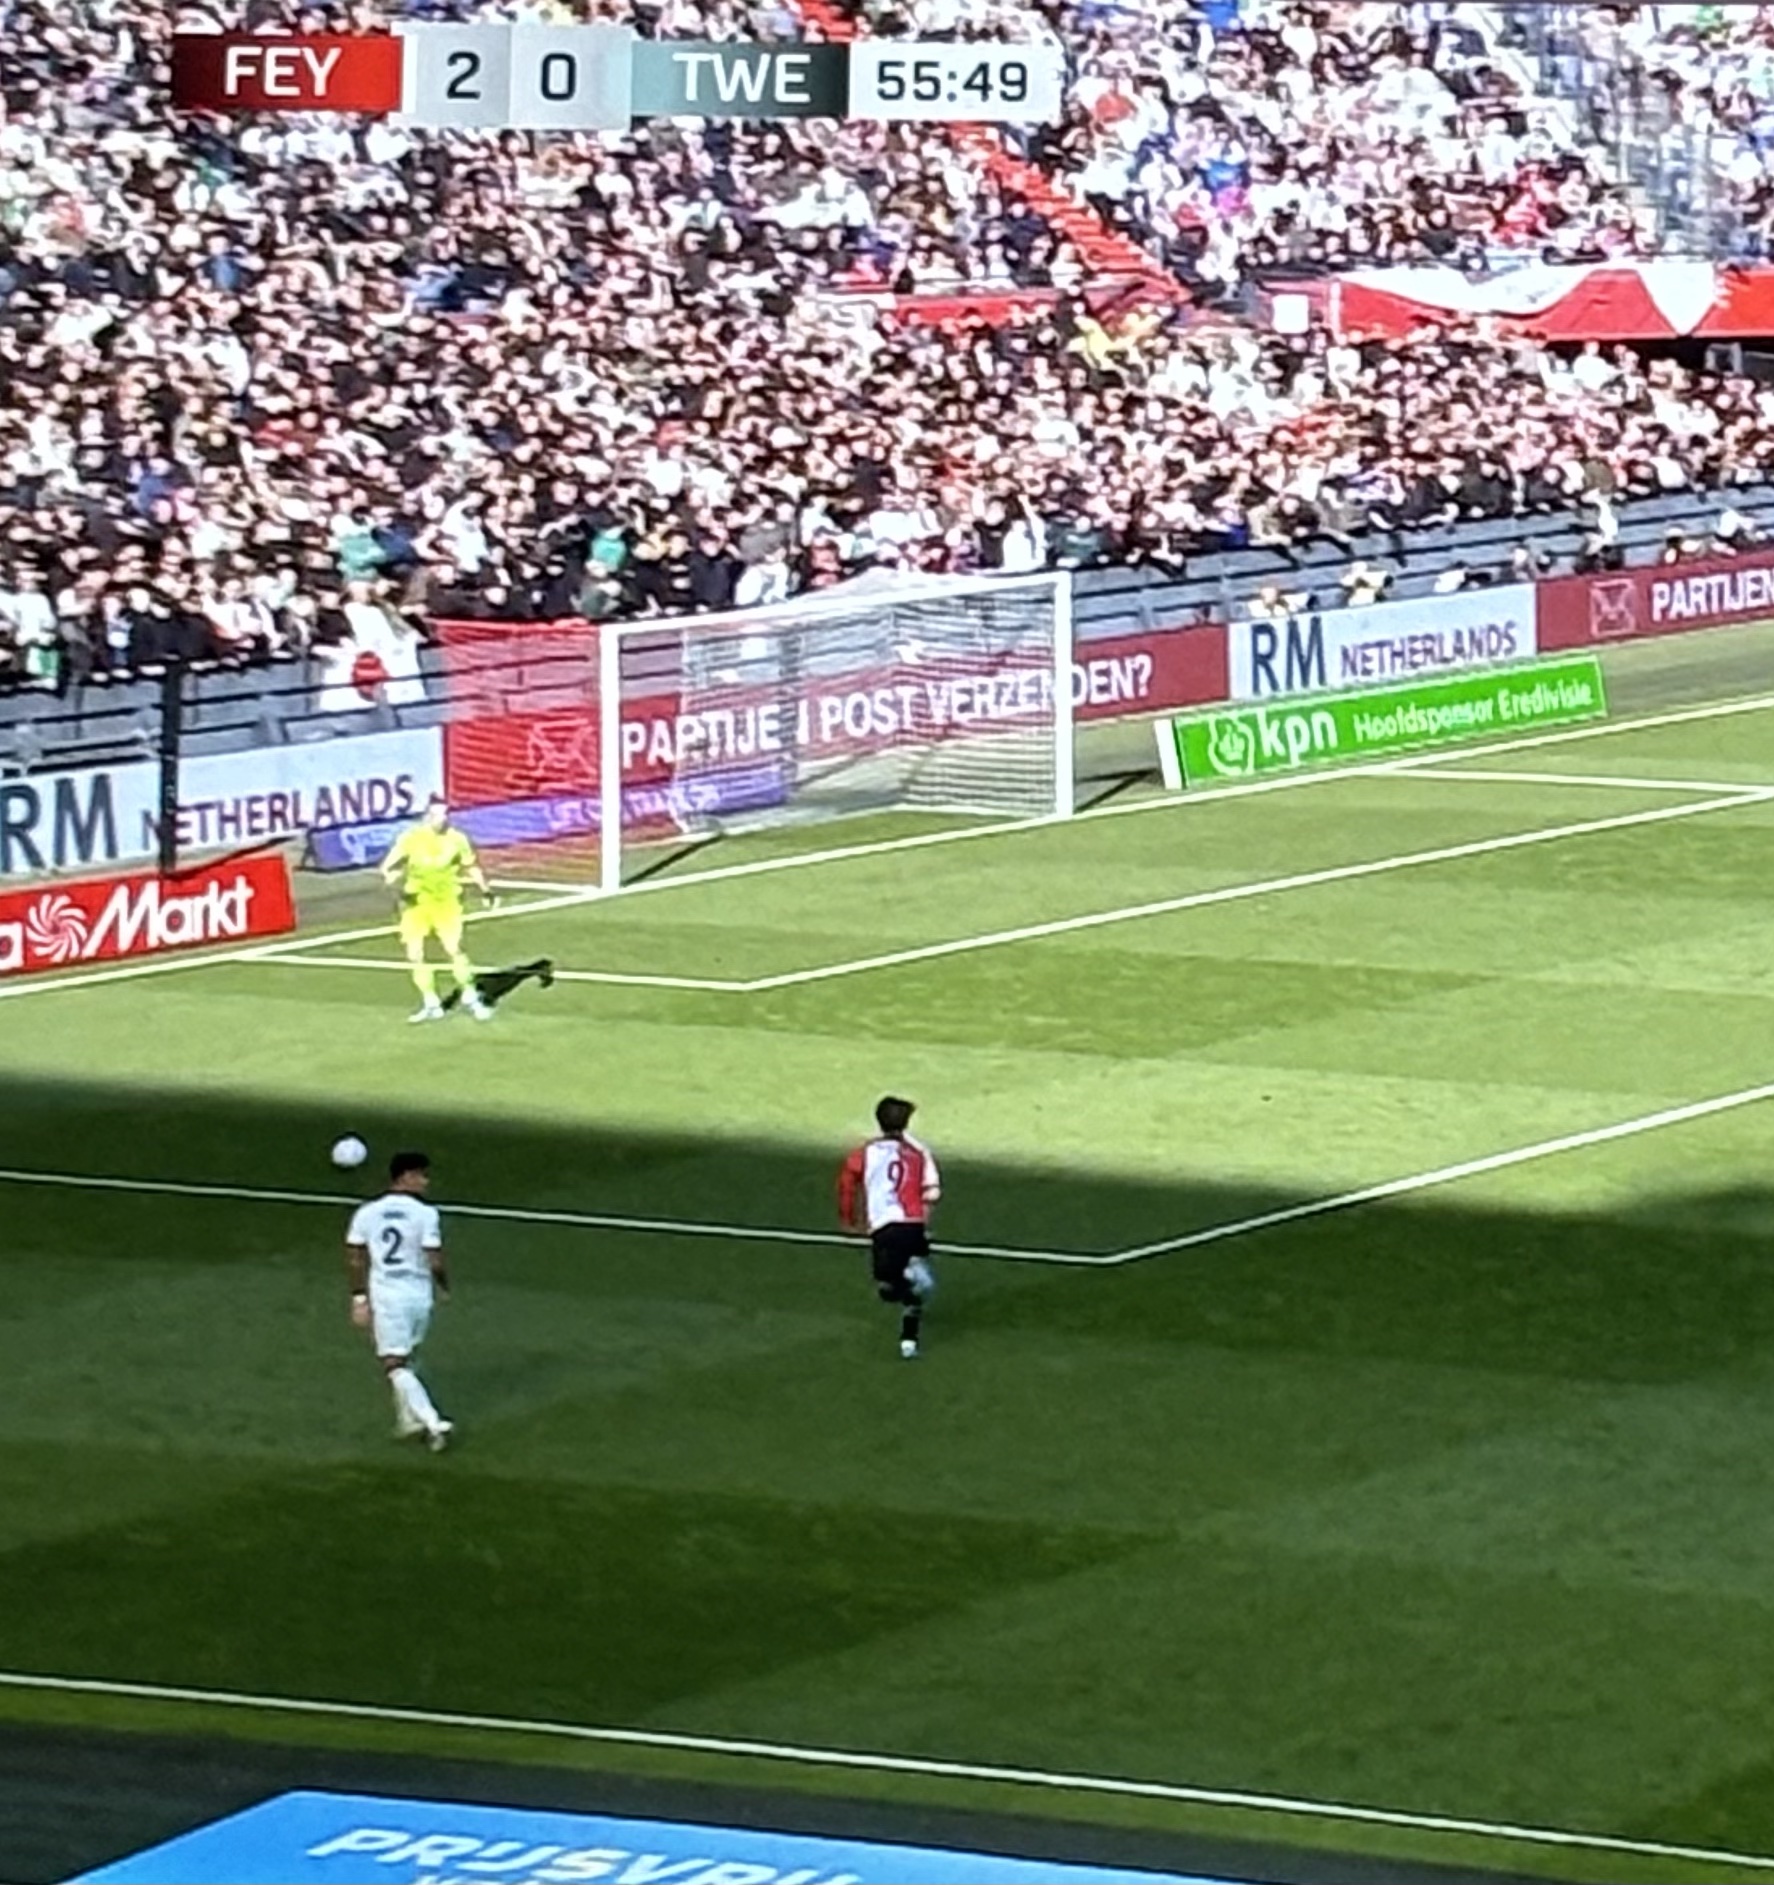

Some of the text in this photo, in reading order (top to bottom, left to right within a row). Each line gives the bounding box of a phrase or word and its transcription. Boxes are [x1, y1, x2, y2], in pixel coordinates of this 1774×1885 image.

[1250, 615, 1518, 696] RM NETHERLANDS
[819, 685, 919, 743] POST
[1258, 680, 1594, 765] kpn Hoofdsponsor Eredivisie
[0, 773, 119, 875] RM
[141, 773, 414, 852] NETHERLANDS
[81, 874, 255, 958] Markt
[886, 1160, 905, 1194] 9
[382, 1226, 403, 1265] 2
